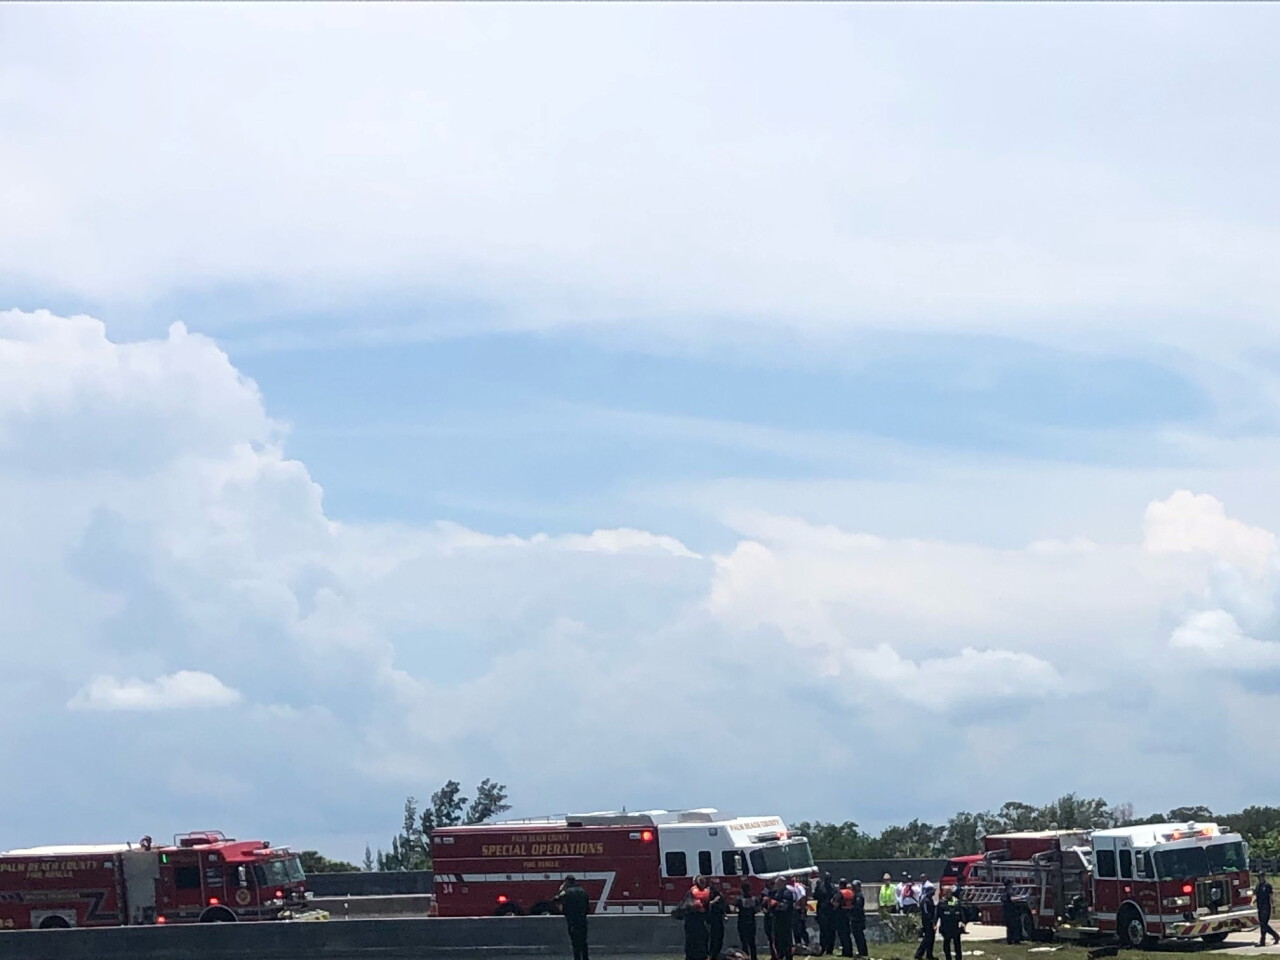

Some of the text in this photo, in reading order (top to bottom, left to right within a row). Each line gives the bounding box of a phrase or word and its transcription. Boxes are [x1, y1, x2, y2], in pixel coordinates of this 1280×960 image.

[482, 842, 604, 856] SPECIAL OPERATIONS
[0, 862, 25, 872] PALM
[61, 861, 97, 870] COUNTY
